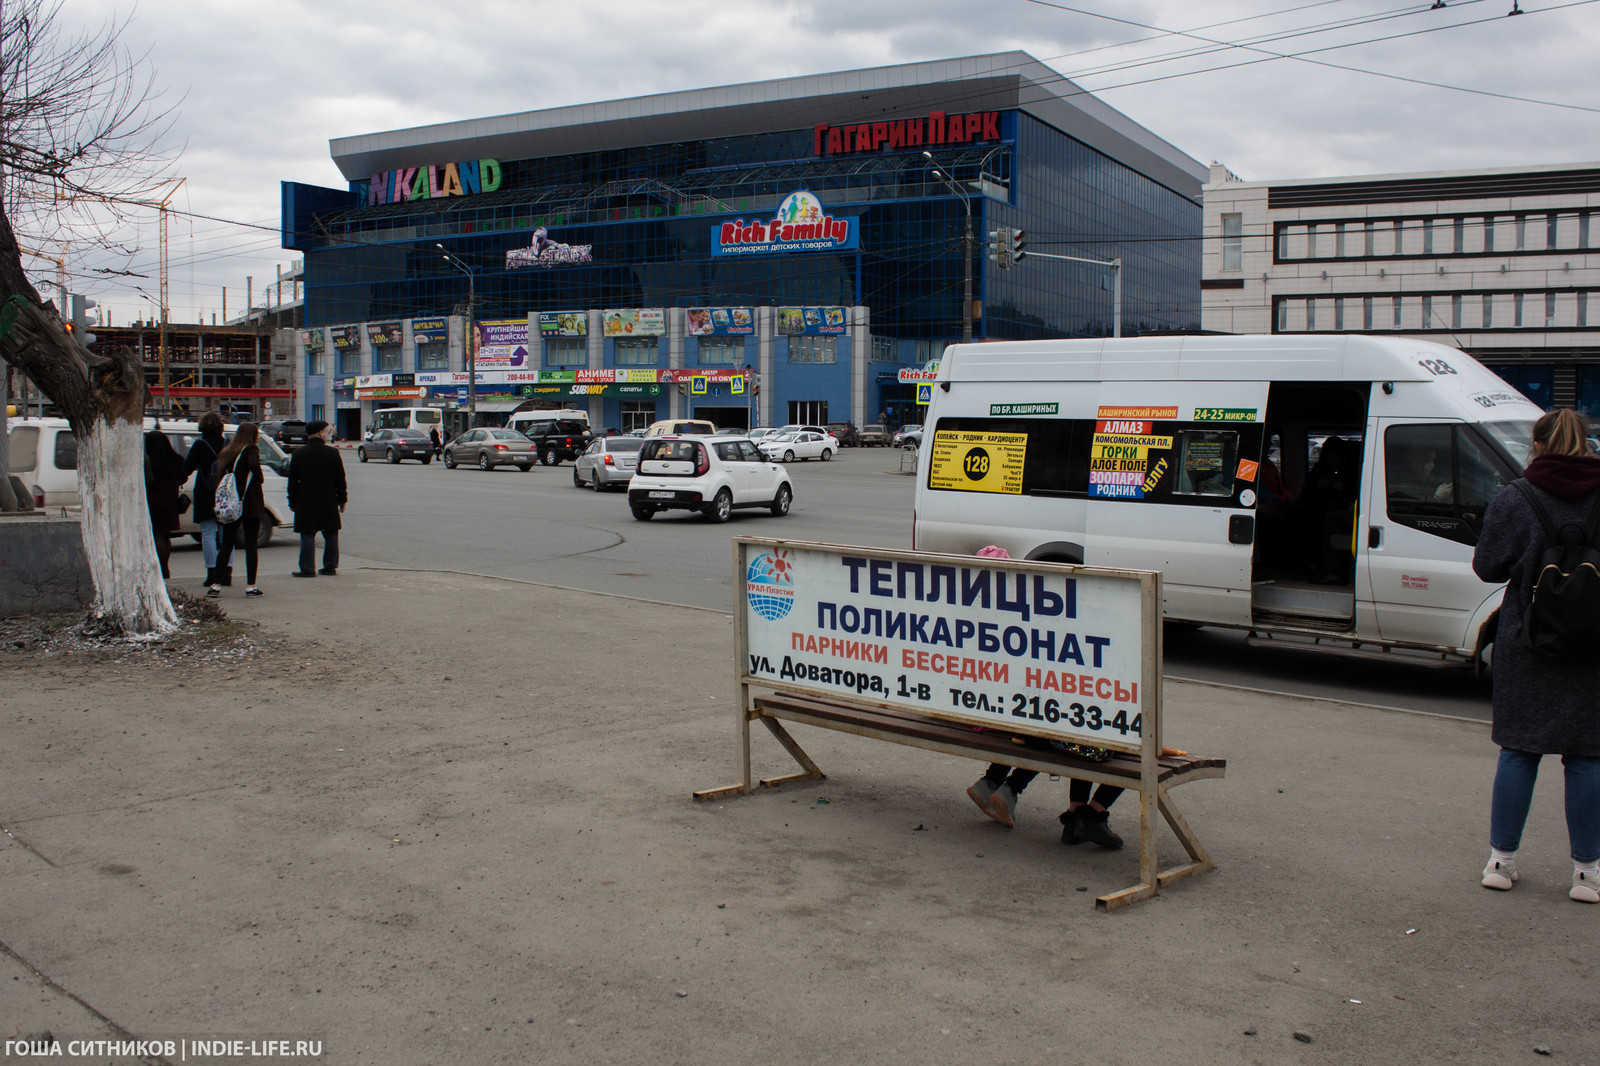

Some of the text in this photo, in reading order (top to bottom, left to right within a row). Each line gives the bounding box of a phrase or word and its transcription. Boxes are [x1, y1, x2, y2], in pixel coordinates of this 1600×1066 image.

[814, 111, 999, 155] ГАГАРИН ПАРК
[368, 158, 502, 206] NIKALAND
[720, 216, 848, 245] Rich Family
[722, 241, 833, 253] гипермаркет детских товаров
[486, 325, 528, 333] КРУПНЕЙШАЯ
[490, 333, 528, 341] ИНДИЙСКАЯ
[577, 369, 614, 378] АНИМЕ
[1418, 359, 1457, 376] 128
[507, 373, 534, 381] 200-44-88
[900, 370, 920, 379] Rich
[569, 384, 608, 395] SUBWAY
[992, 404, 1056, 414] ПО БР. КАШИРИНЫХ
[1098, 407, 1177, 417] КАШИРИНСКИЙ РЫНОК
[1194, 409, 1256, 420] 24-25 МИКР-ОН
[1104, 421, 1143, 434] АЛМАЗ
[937, 433, 1025, 444] КОПЕЙСК РОДНИК КАРДИОЦЕНТР
[1095, 435, 1170, 447] КОМСОМОЛЬСКАЯ ПЛ.
[1101, 446, 1138, 459] ГОРКИ
[965, 455, 989, 474] 128
[1091, 459, 1147, 472] АЛОЕ ПОЛЕ
[1090, 472, 1142, 485] ЗООПАРК
[1141, 457, 1169, 493] ЧЕЛГУ
[1096, 485, 1136, 497] РОДНИК
[1416, 520, 1459, 530] TRANSIT
[747, 583, 794, 597] УРАЛ-Пластик
[842, 556, 1077, 621] ТЕПЛИЦЫ
[818, 601, 1110, 668] ПОЛИКАРБОНАТ
[792, 632, 1138, 704] ПАРНИКИ БЕСЕДКИ НАВЕСЫ
[750, 655, 1142, 738] ул. Доватора, 1-в тел.: 216-33-44
